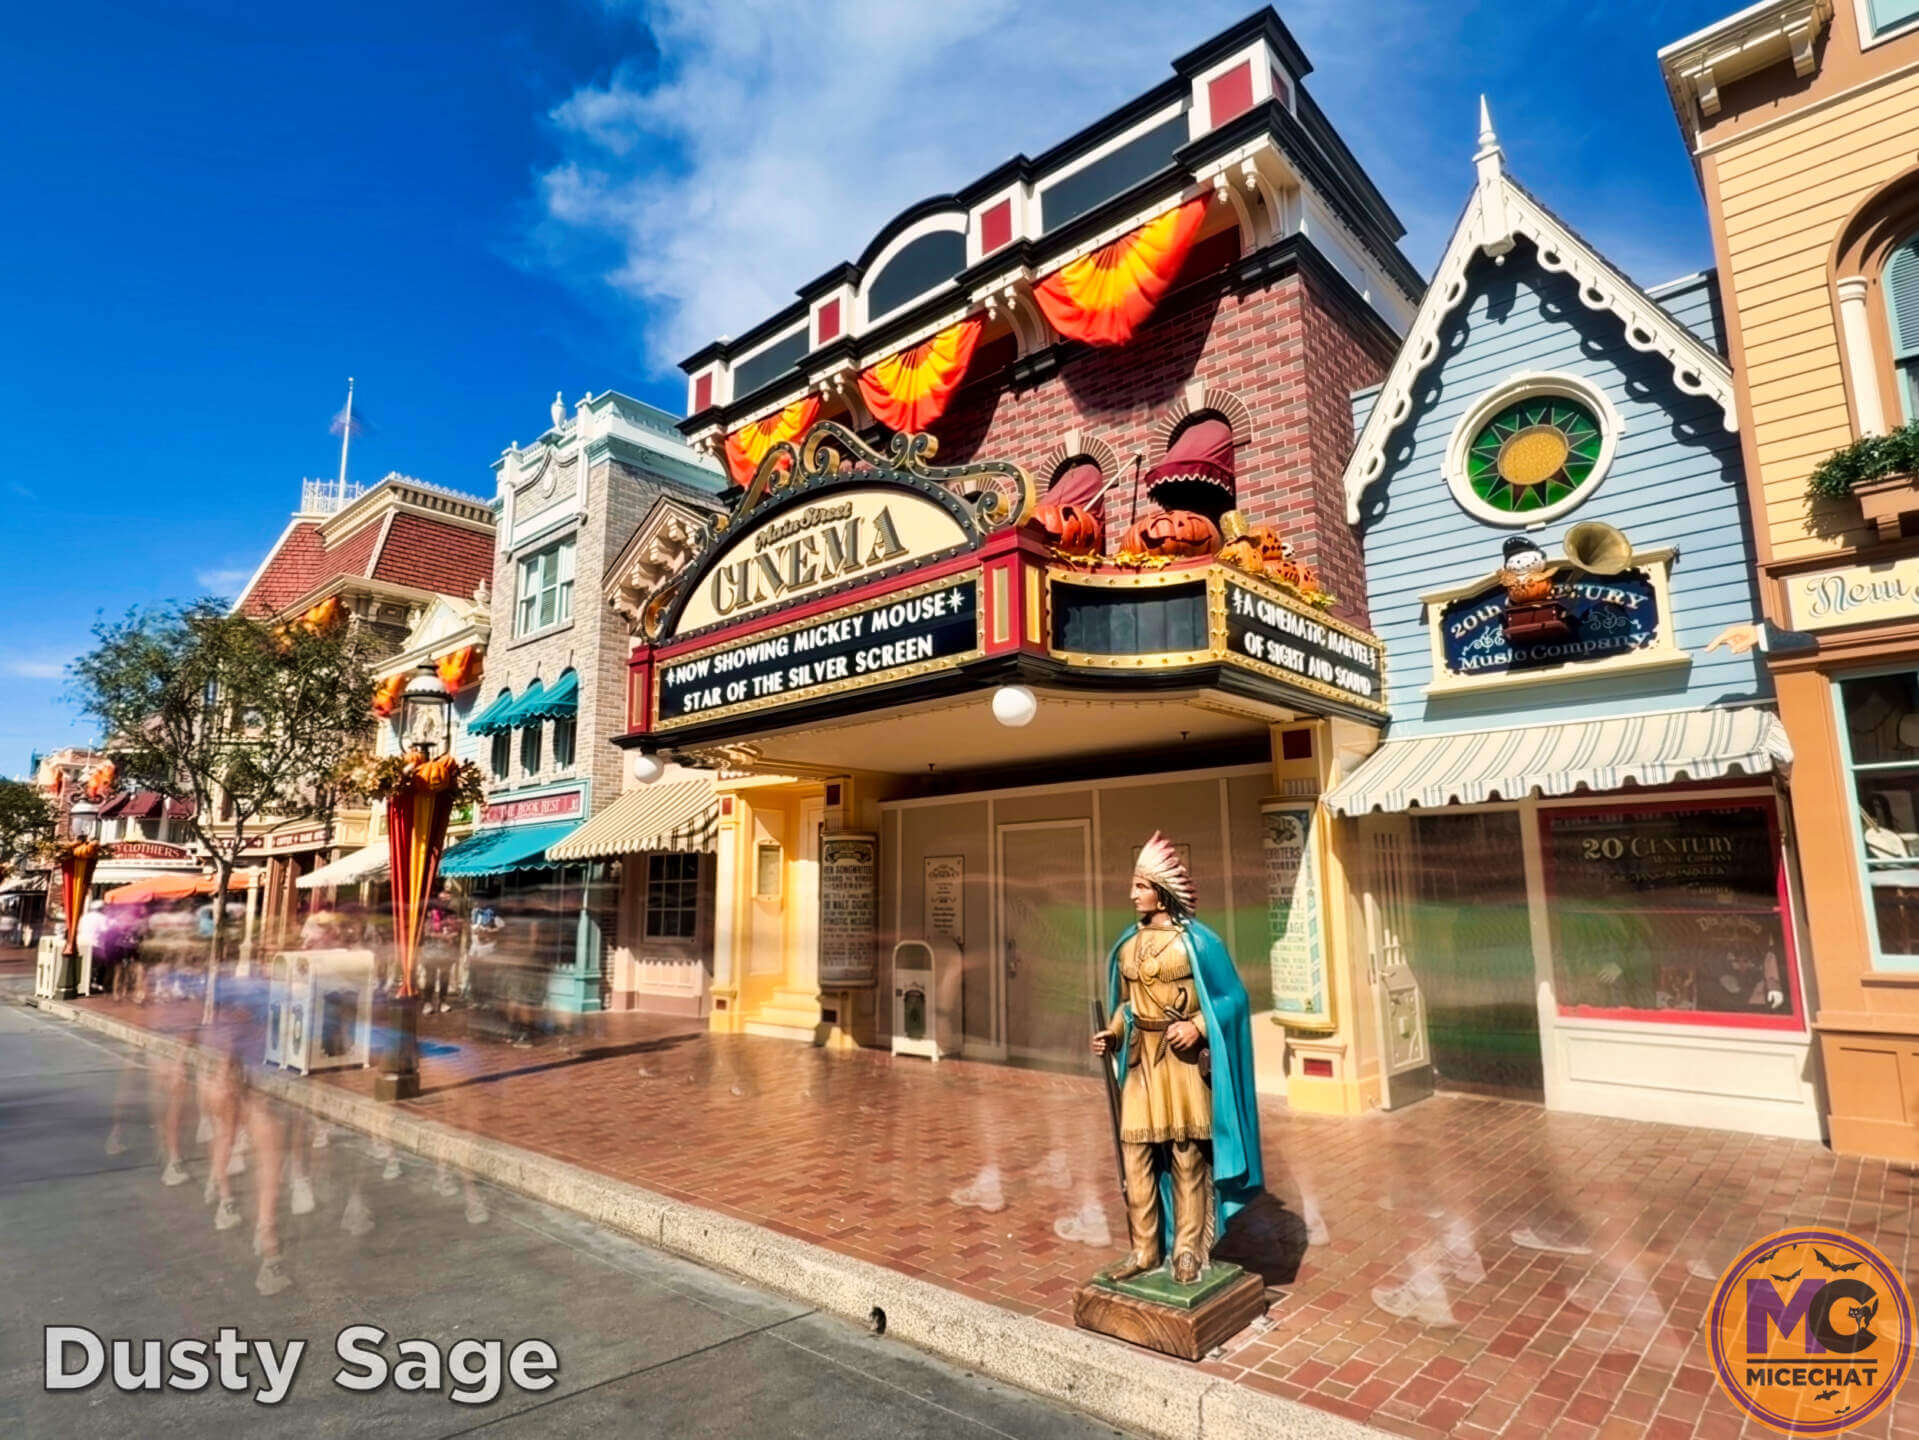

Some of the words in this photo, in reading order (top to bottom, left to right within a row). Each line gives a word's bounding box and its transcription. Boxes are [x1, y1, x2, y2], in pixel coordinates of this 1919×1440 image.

[755, 522, 801, 553] Main
[801, 501, 853, 530] Street
[711, 504, 909, 616] CINEMA
[1451, 603, 1502, 639] 20th
[1804, 576, 1911, 618] New
[675, 661, 709, 686] NOW
[713, 637, 789, 675] SHOWING
[793, 615, 864, 653] MICKEY
[871, 592, 946, 633] MOUSE
[1242, 593, 1255, 618] A
[1256, 600, 1327, 646] CINEMATIC
[1327, 631, 1369, 665] MARVEL
[1530, 632, 1651, 661] Company
[683, 688, 722, 713] STAR
[726, 680, 748, 701] OF
[752, 672, 783, 696] THE
[788, 656, 849, 689] SILVER
[855, 633, 933, 673] SCREEN
[1243, 632, 1265, 658] OF
[1266, 639, 1306, 673] SIGHT
[1307, 656, 1334, 682] AND
[1334, 666, 1372, 697] SOUND
[122, 843, 180, 857] CLOTHIERS
